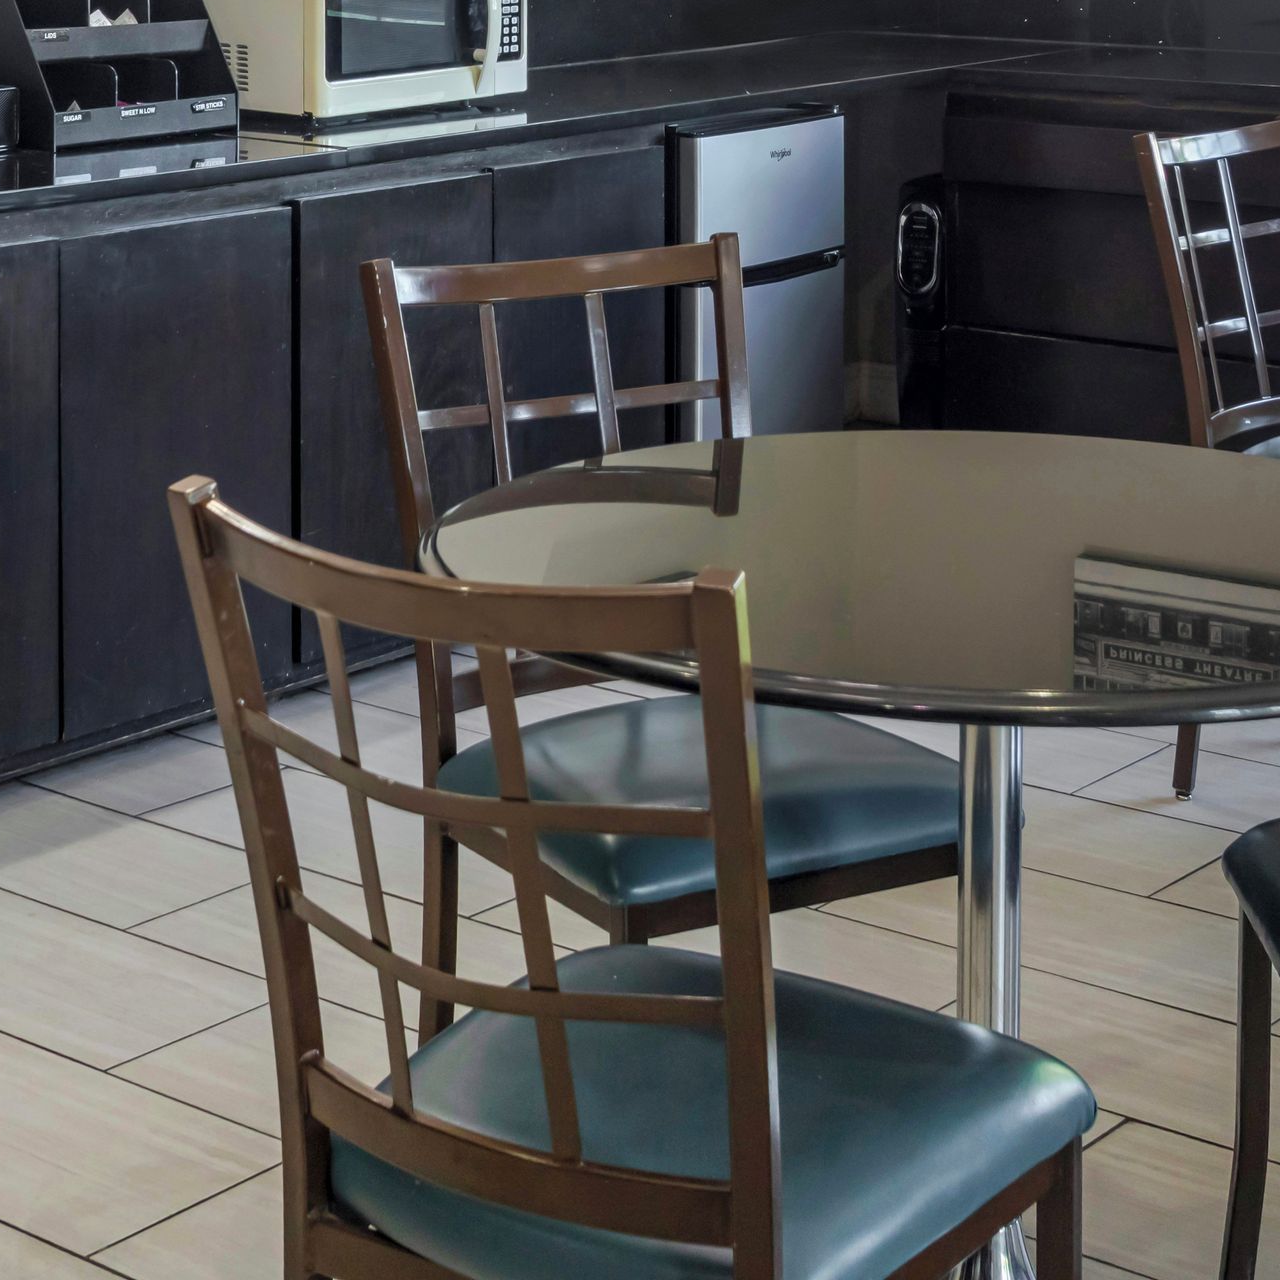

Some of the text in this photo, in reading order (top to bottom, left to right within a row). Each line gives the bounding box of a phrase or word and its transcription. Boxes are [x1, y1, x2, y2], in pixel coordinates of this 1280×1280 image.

[44, 31, 57, 39] LIDS
[121, 107, 139, 117] SWEET
[144, 106, 156, 114] LOW
[63, 114, 83, 123] SUGAR
[769, 147, 792, 162] Whirlpool
